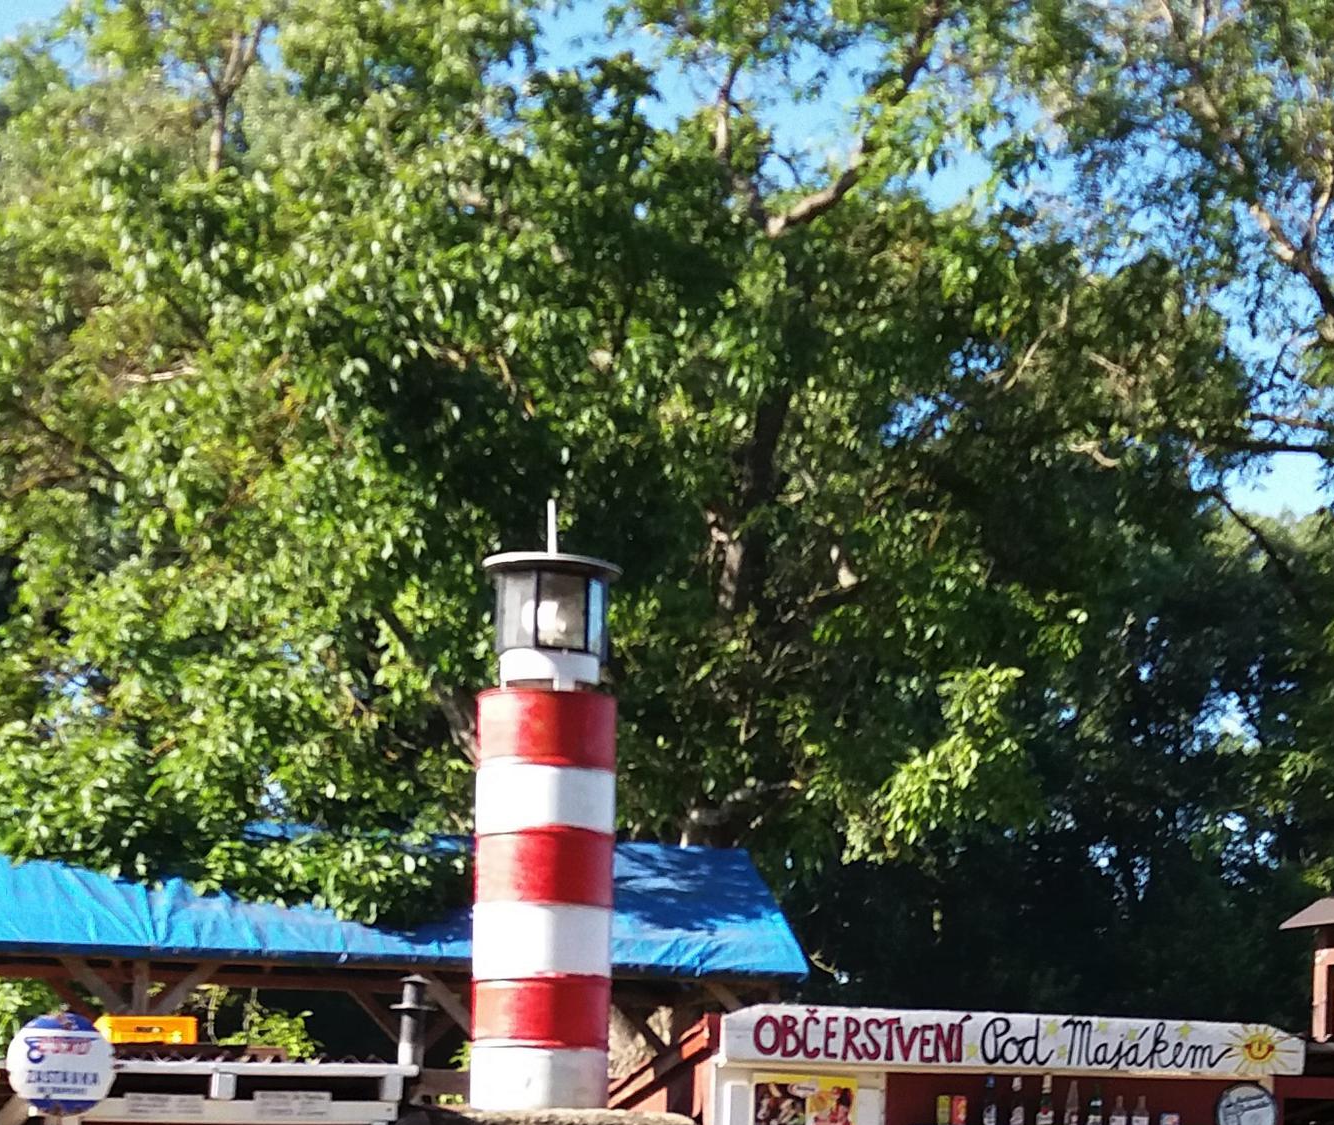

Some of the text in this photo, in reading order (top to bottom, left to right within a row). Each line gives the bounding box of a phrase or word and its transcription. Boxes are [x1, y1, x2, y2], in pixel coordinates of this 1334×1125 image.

[753, 1008, 1233, 1070] OBČERSTVENÍ Pod Majákem
